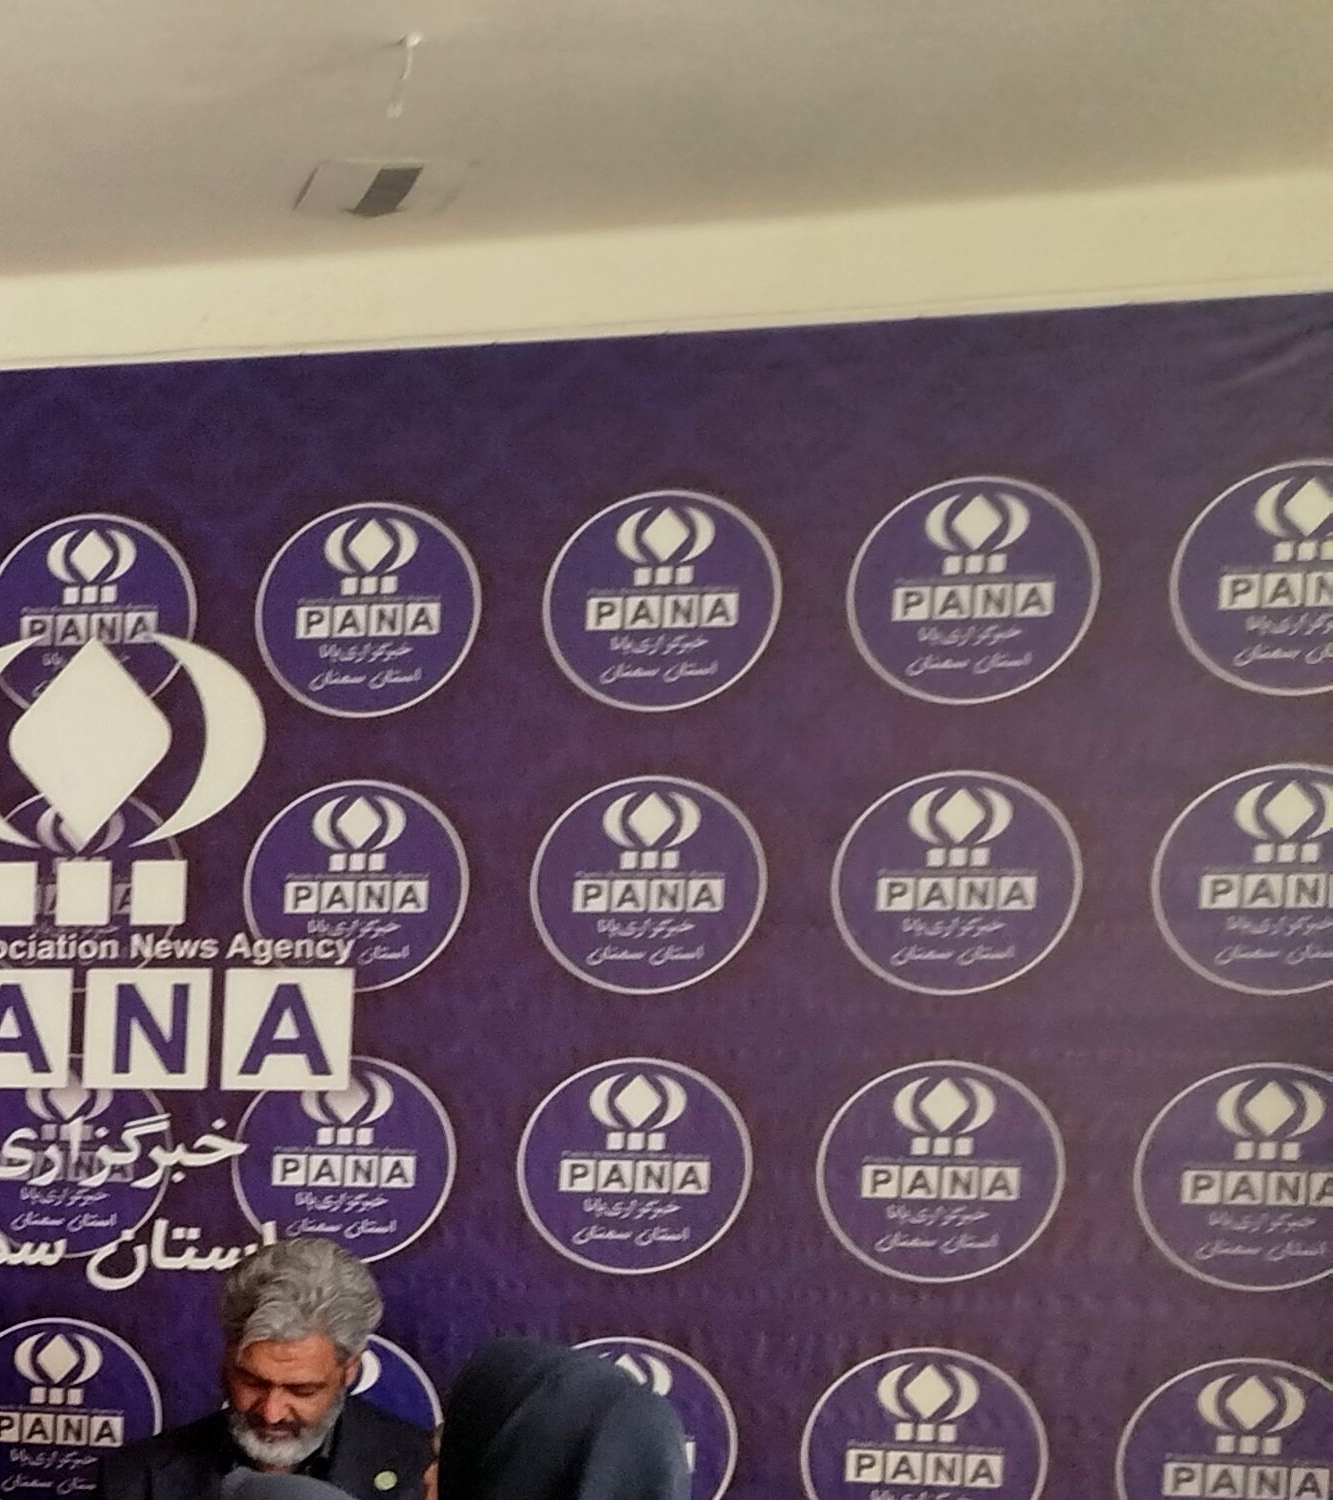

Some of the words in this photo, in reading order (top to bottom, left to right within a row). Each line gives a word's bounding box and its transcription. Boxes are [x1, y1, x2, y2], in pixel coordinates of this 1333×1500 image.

[897, 584, 1051, 620] PANA
[1224, 571, 1333, 608] PAN
[301, 604, 438, 637] PANA
[591, 595, 736, 629] PANA
[24, 613, 155, 646] PANA
[289, 883, 425, 913] PANA
[578, 881, 722, 911] PANA
[882, 878, 1034, 910] PANA
[1205, 875, 1333, 908] PAN
[130, 932, 219, 960] News
[227, 932, 356, 966] Agency
[277, 1155, 413, 1187] PANA
[564, 1161, 707, 1193] PANA
[866, 1167, 1018, 1200] PANA
[1186, 1173, 1333, 1207] PANA
[850, 1451, 1001, 1487] PANA
